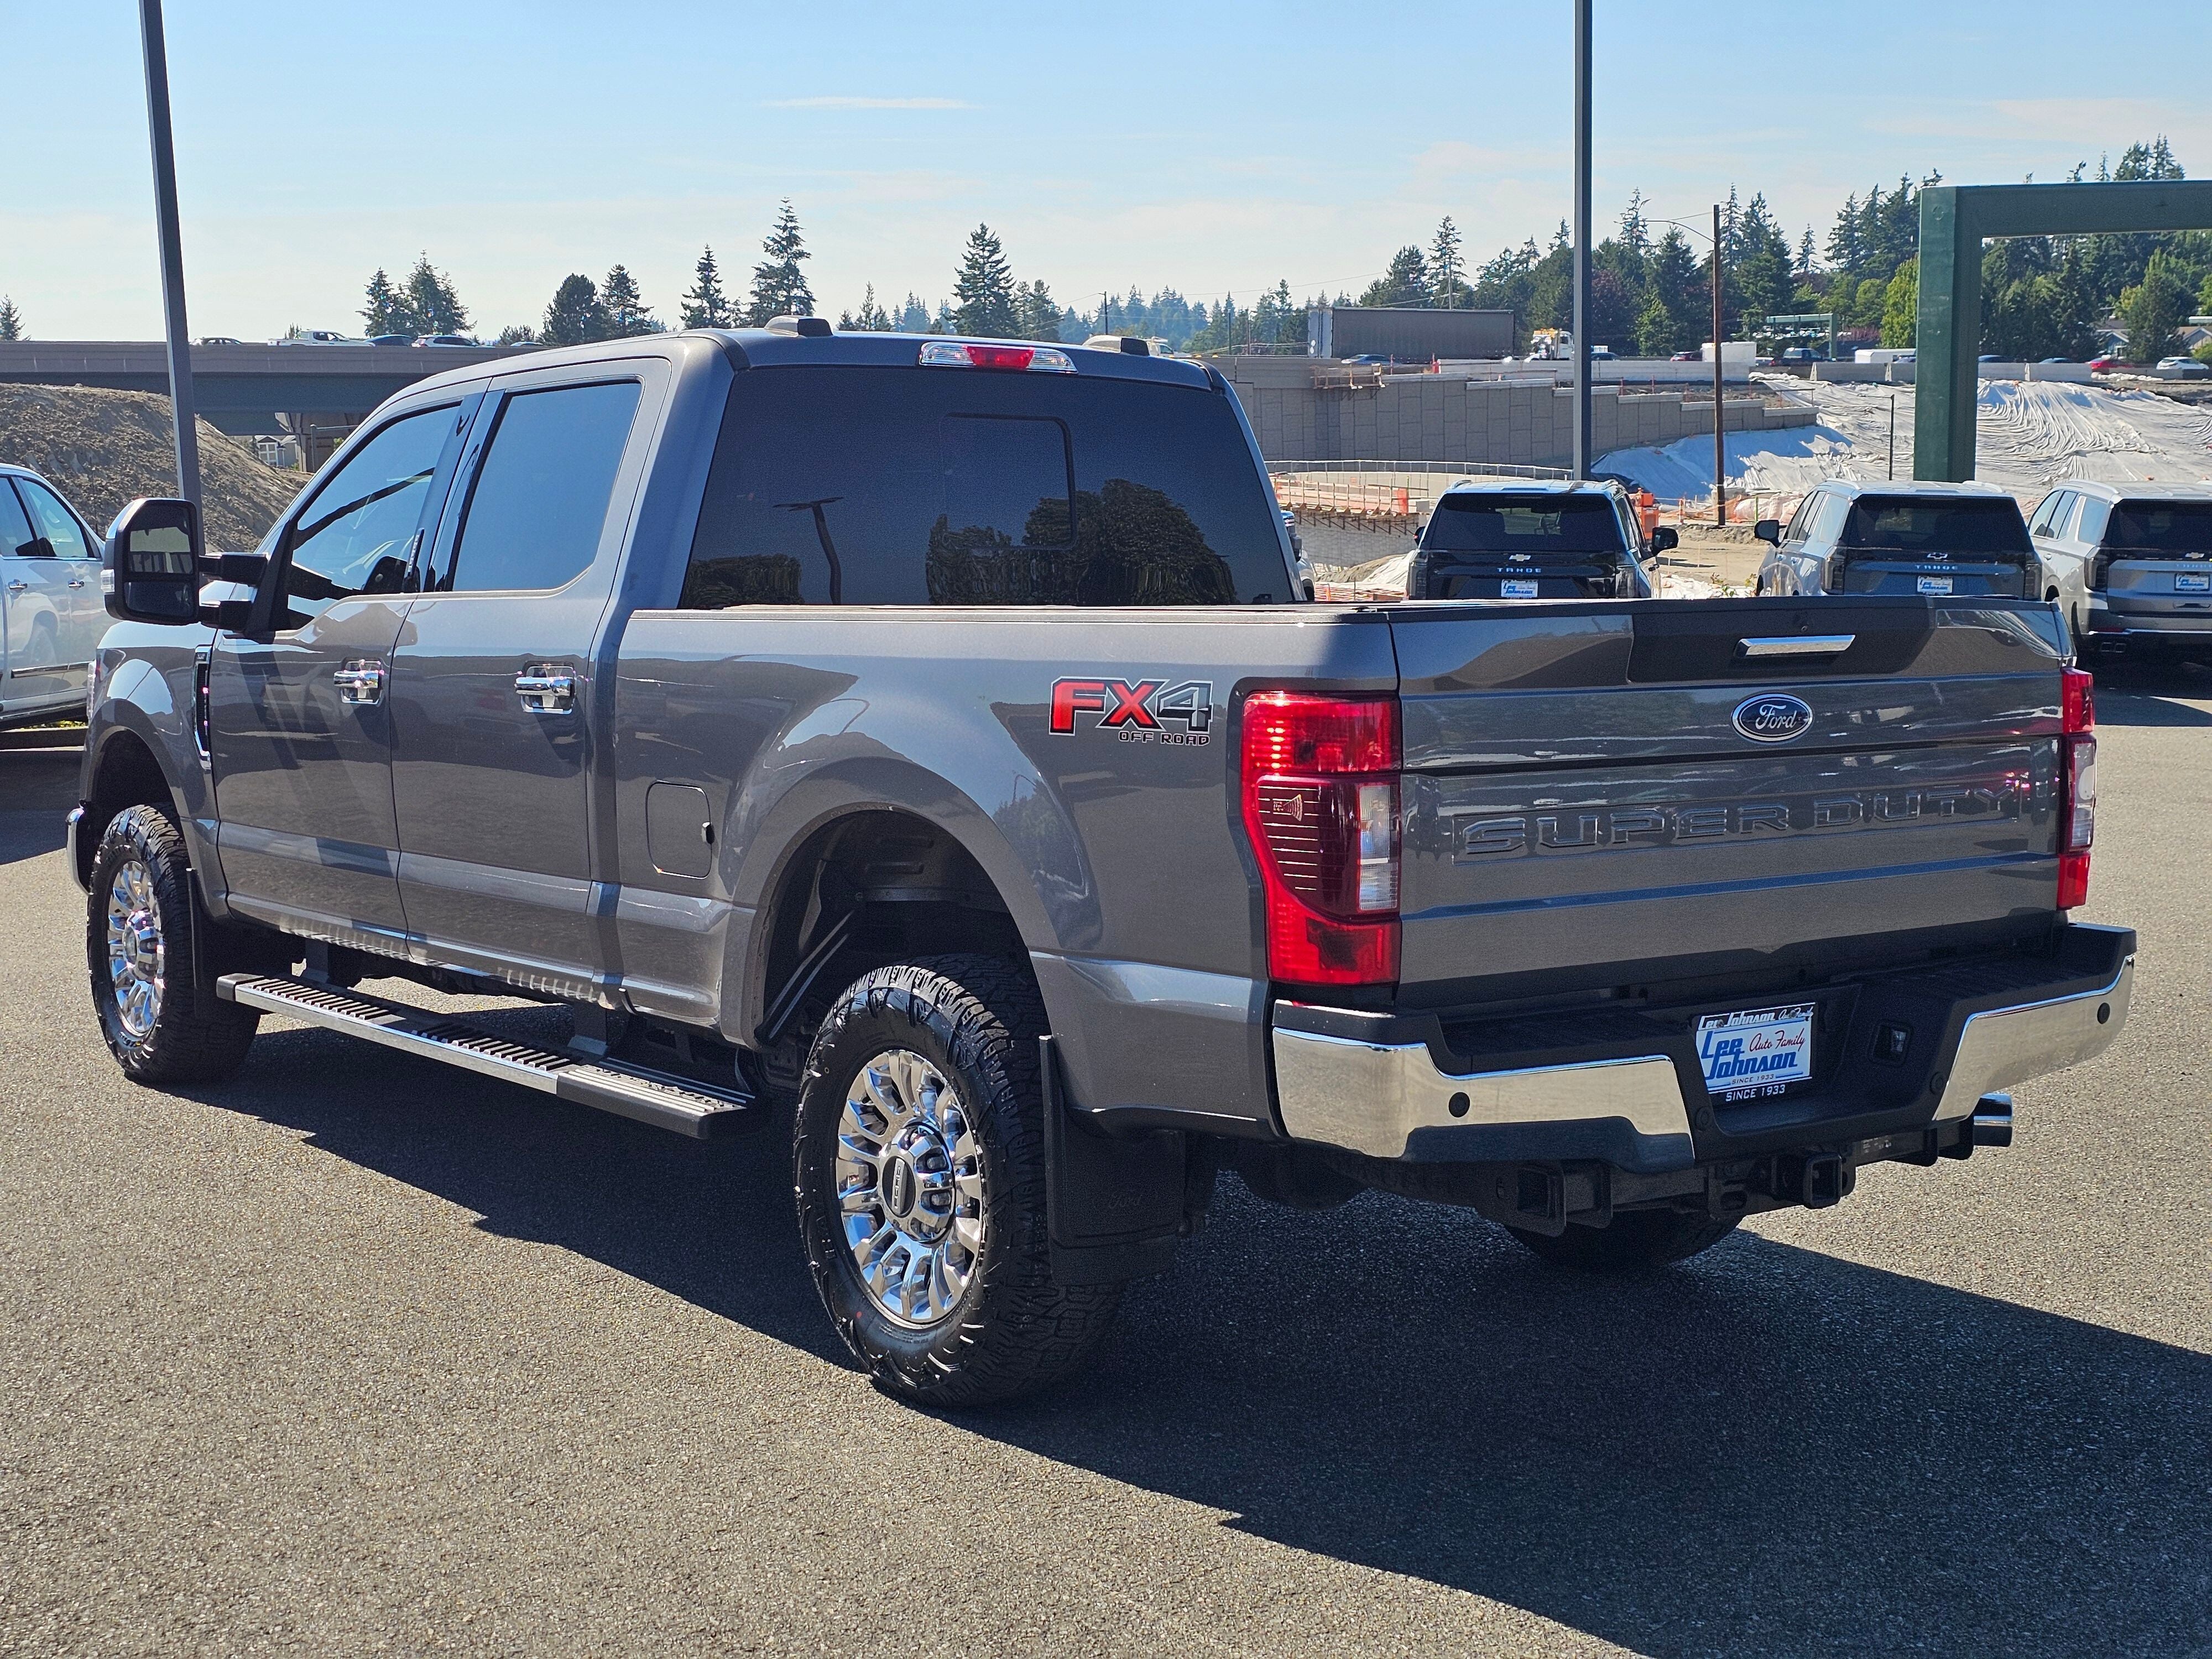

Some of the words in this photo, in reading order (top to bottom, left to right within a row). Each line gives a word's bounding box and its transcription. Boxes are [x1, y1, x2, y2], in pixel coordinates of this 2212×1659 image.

[1049, 676, 1213, 736] FX4
[1755, 704, 1797, 729] Ford
[1118, 731, 1154, 743] OFF
[1160, 733, 1211, 746] ROAD
[1463, 804, 1790, 855] SUPER
[1813, 784, 2015, 828] DUTY
[1724, 1011, 1776, 1027] Johnson
[1701, 1031, 1745, 1059] Lee
[1750, 1033, 1772, 1052] Auto
[1775, 1027, 1806, 1052] Family
[1705, 1050, 1798, 1079] Johnson
[1725, 1088, 1756, 1102] SINCE
[1761, 1084, 1786, 1097] 1933
[1731, 1076, 1754, 1085] SINCE
